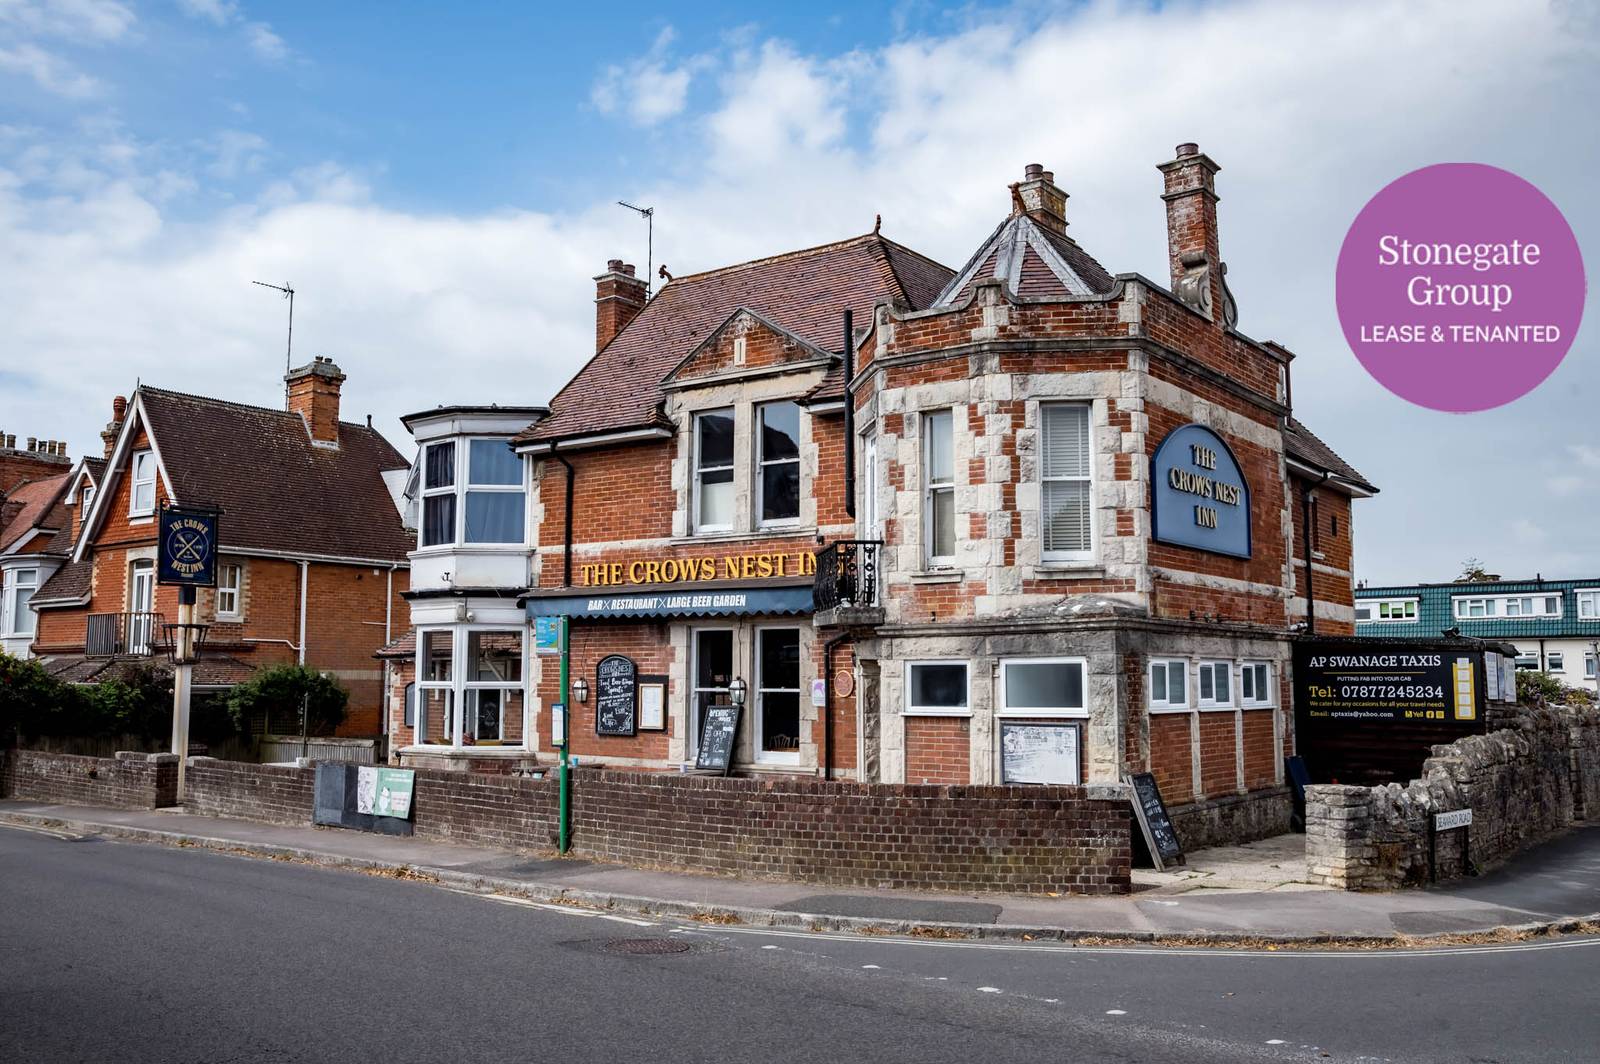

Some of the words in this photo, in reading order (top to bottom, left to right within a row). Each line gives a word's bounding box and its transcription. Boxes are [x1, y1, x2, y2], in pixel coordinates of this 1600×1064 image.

[1193, 444, 1217, 470] THE
[1170, 467, 1213, 498] CROWS
[1215, 481, 1242, 506] NEST
[1196, 504, 1218, 529] INN
[170, 520, 183, 532] THE
[184, 518, 209, 535] CROWS
[171, 560, 190, 573] NEST
[190, 561, 205, 573] INN
[580, 563, 623, 586] THE
[629, 557, 717, 585] CROWS
[725, 553, 789, 579] NEST
[587, 600, 603, 611] BAR
[610, 598, 658, 610] RESTAURANT
[666, 595, 692, 608] LARGE
[692, 595, 713, 607] BEER
[713, 594, 746, 607] GARDEN
[1309, 656, 1327, 667] AP
[1329, 655, 1398, 667] SWANAGE
[1399, 655, 1442, 667] TAXIS
[1309, 685, 1337, 698] Tel:
[1341, 685, 1444, 698] 07877245234
[1459, 812, 1471, 824] ROAD
